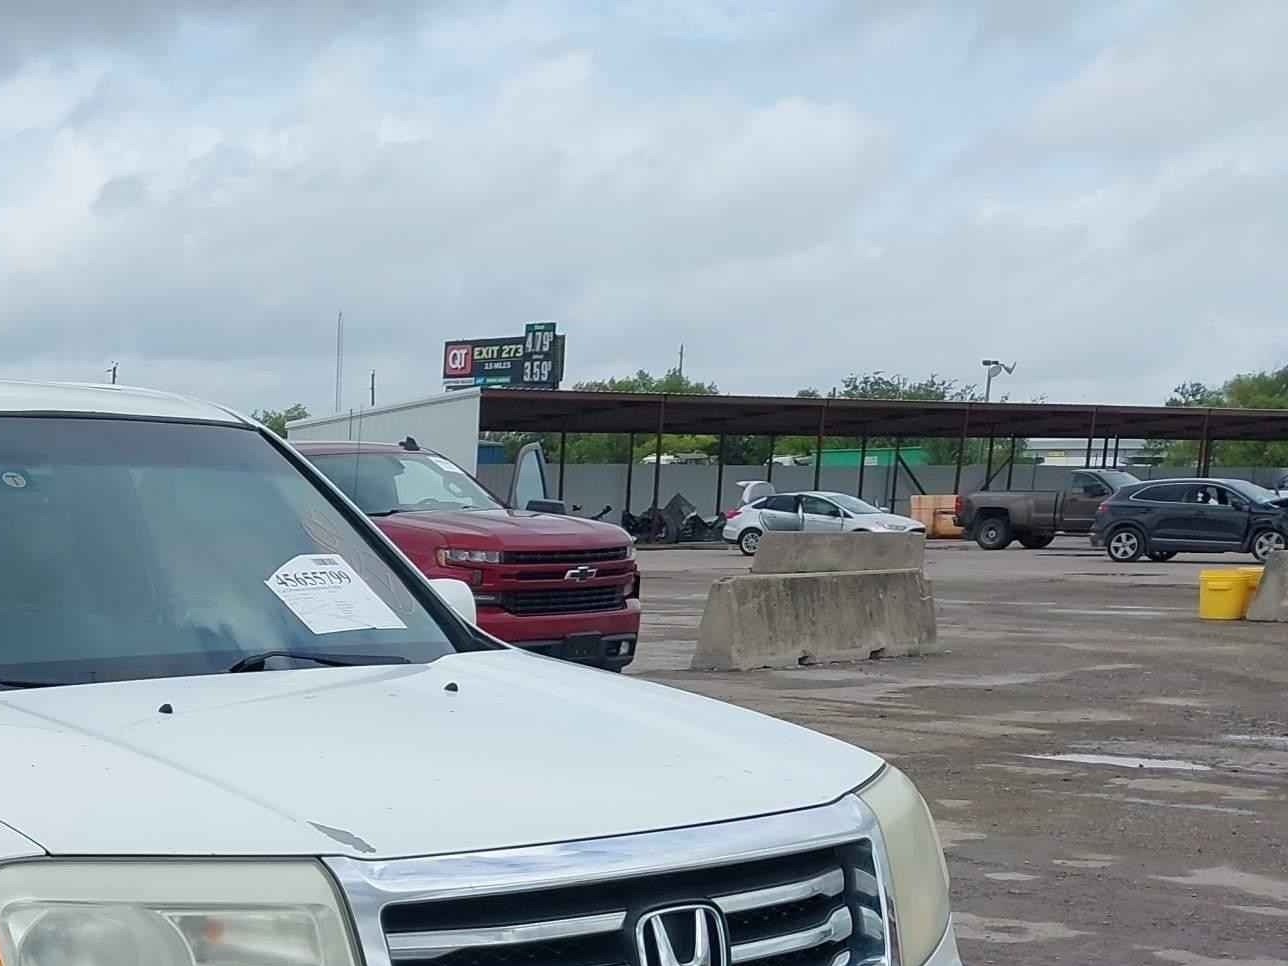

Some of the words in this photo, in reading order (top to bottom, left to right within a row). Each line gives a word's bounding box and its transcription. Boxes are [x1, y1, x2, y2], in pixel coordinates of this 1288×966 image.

[473, 346, 499, 360] EXIT
[501, 344, 523, 358] 273
[494, 362, 511, 370] MILES
[275, 570, 352, 588] 45655799
